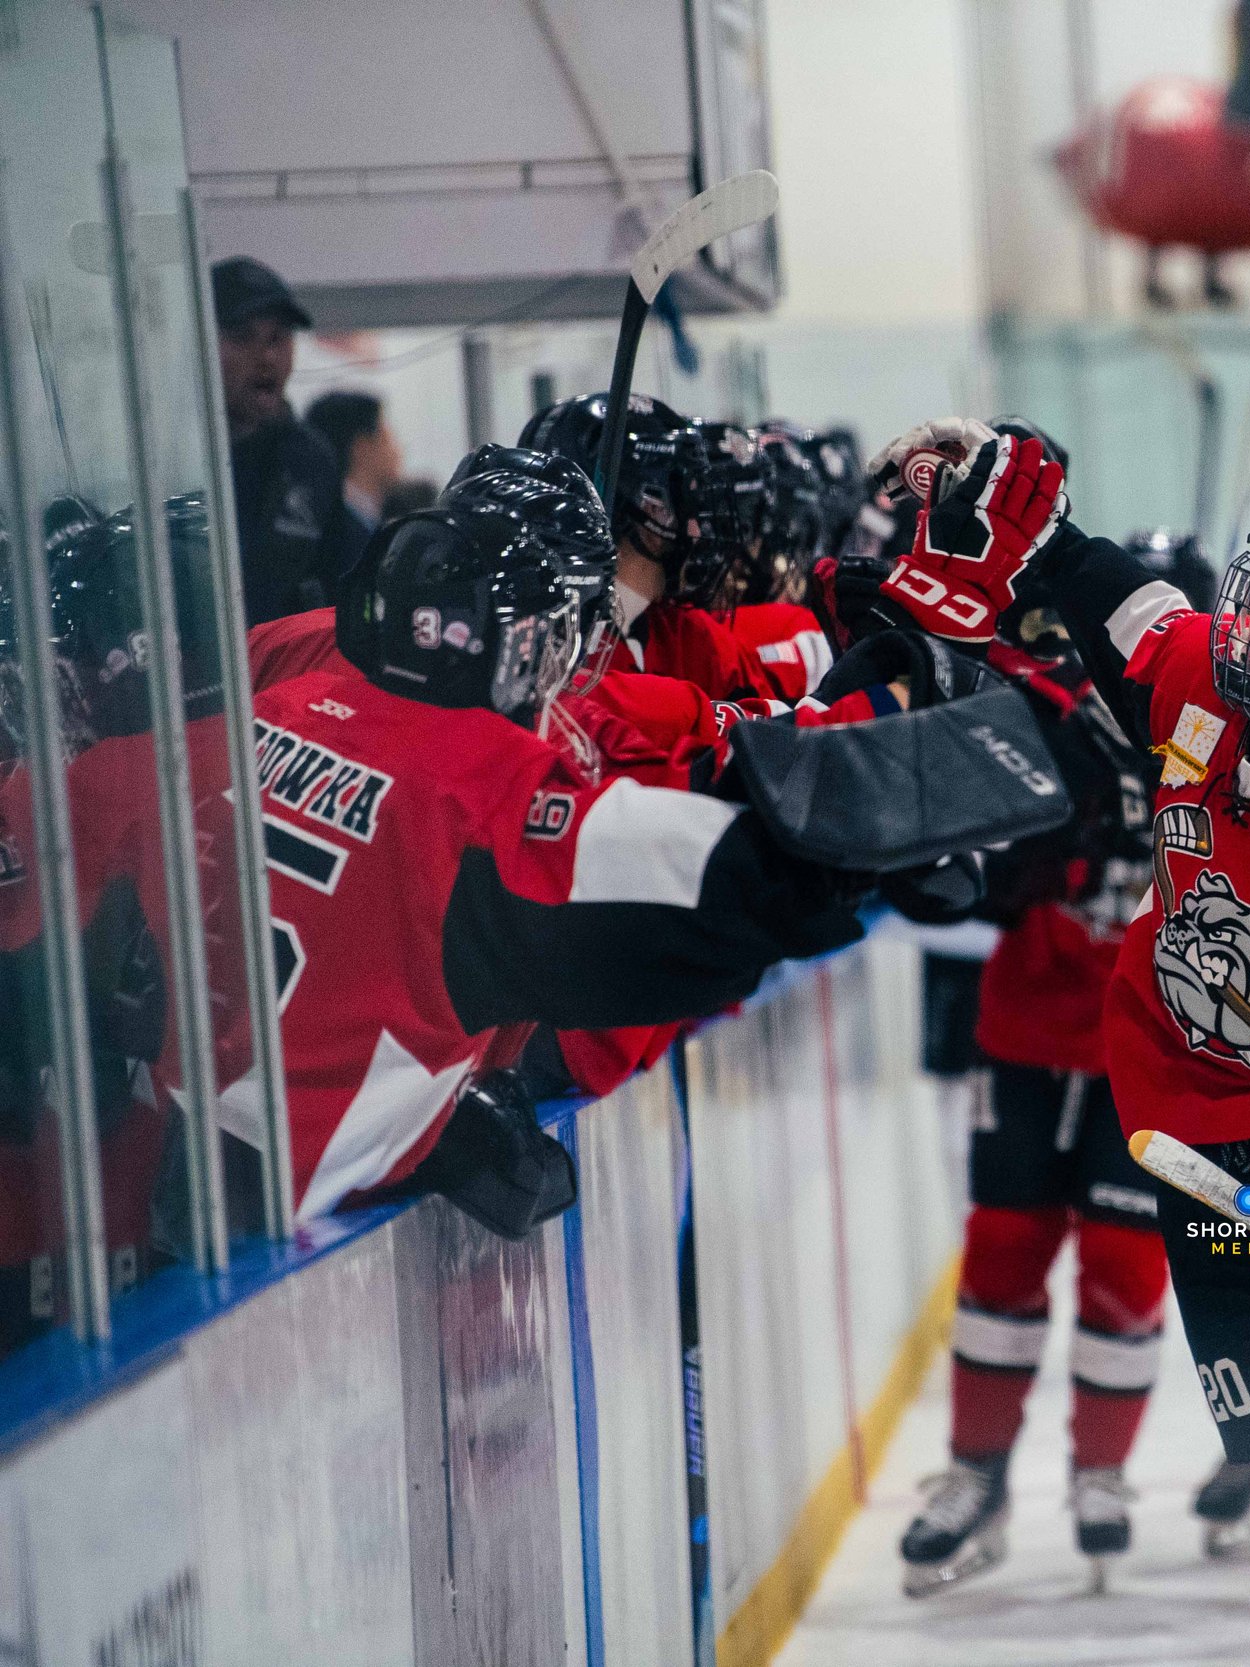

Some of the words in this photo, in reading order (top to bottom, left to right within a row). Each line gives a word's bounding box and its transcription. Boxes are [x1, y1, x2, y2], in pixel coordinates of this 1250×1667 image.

[413, 606, 442, 650] 3
[887, 561, 989, 629] CC
[254, 717, 395, 844] OWKA
